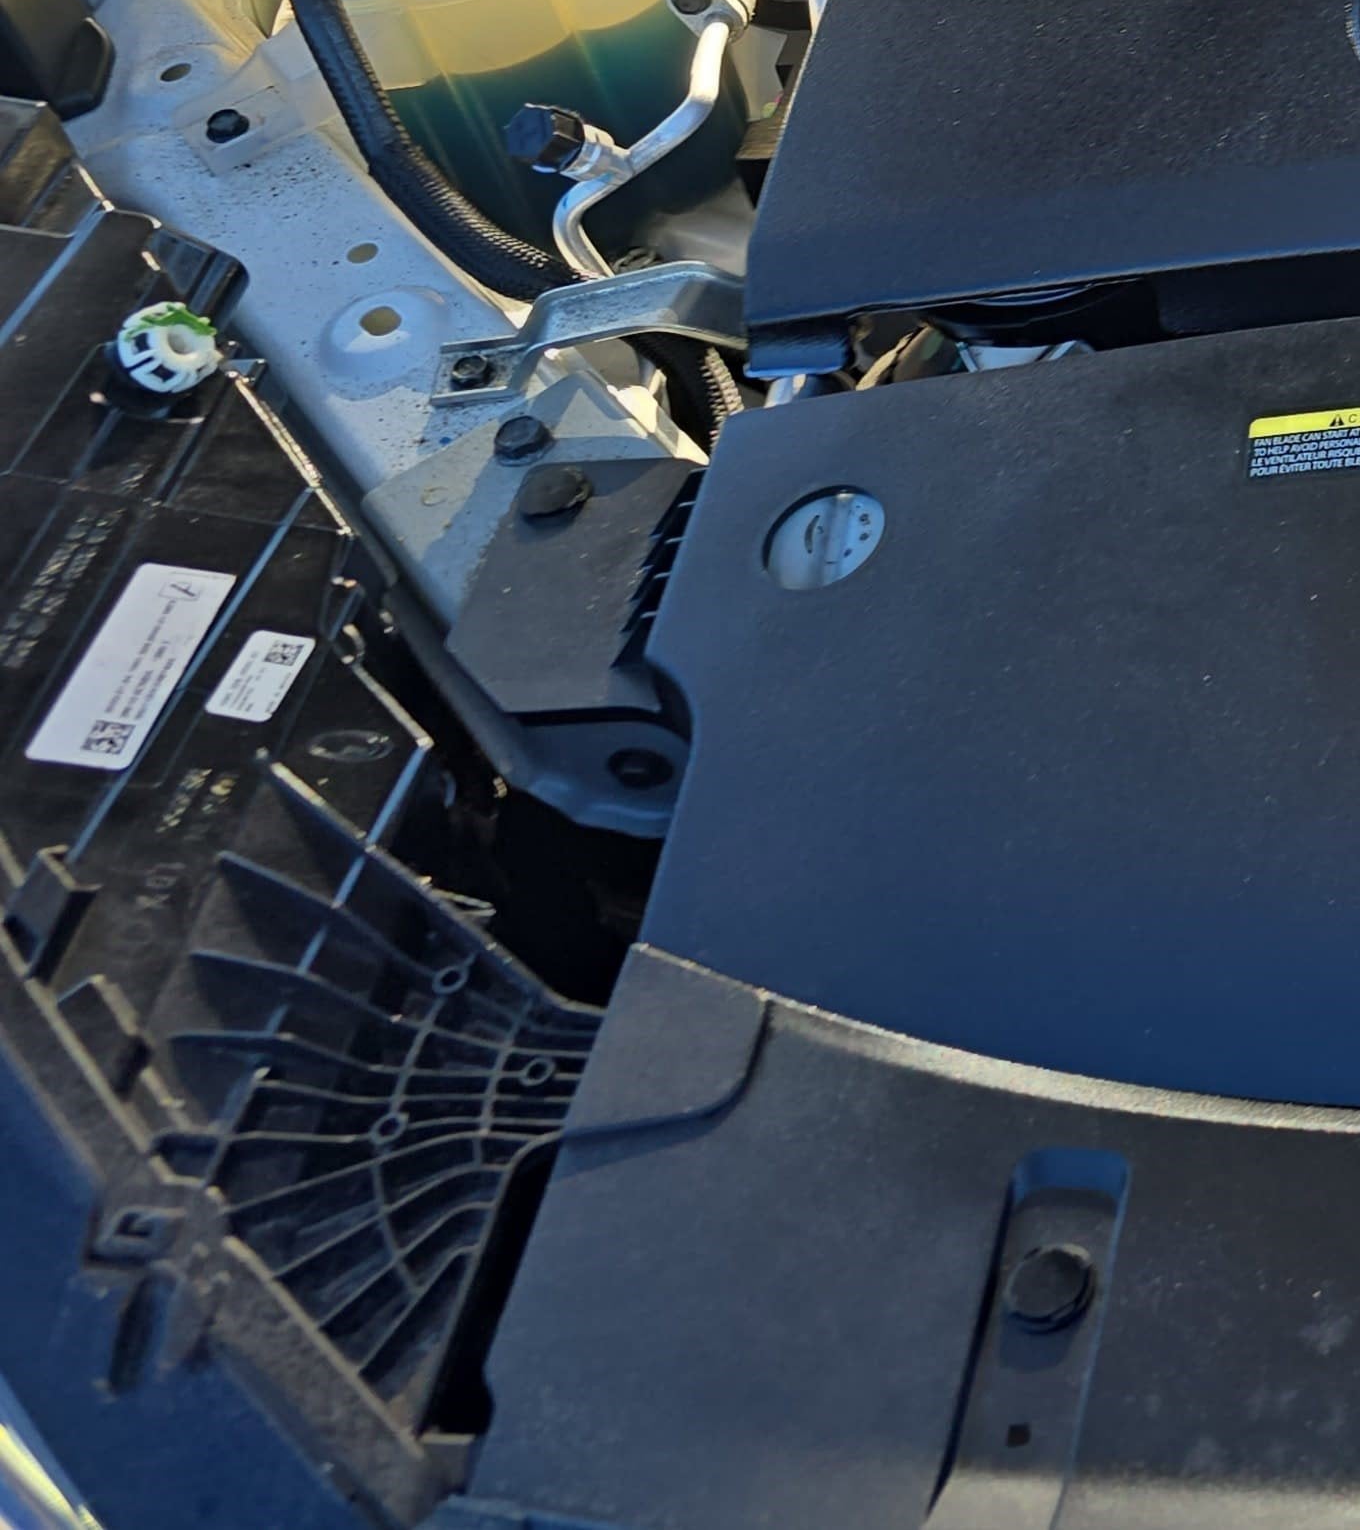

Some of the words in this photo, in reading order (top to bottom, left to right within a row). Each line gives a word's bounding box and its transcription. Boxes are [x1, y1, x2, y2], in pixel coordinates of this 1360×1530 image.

[1254, 437, 1271, 447] FAN
[1273, 434, 1300, 445] BLADE
[1302, 432, 1321, 442] CAN
[1323, 429, 1348, 440] START
[1349, 427, 1360, 437] AT
[1254, 447, 1266, 457] TO
[1268, 445, 1290, 455] HELP
[1290, 443, 1317, 453] AVOID
[1250, 466, 1278, 477] POUR
[1312, 458, 1343, 470] TOUTE
[1252, 457, 1263, 467] LE
[1263, 451, 1327, 466] VENTILATEUR
